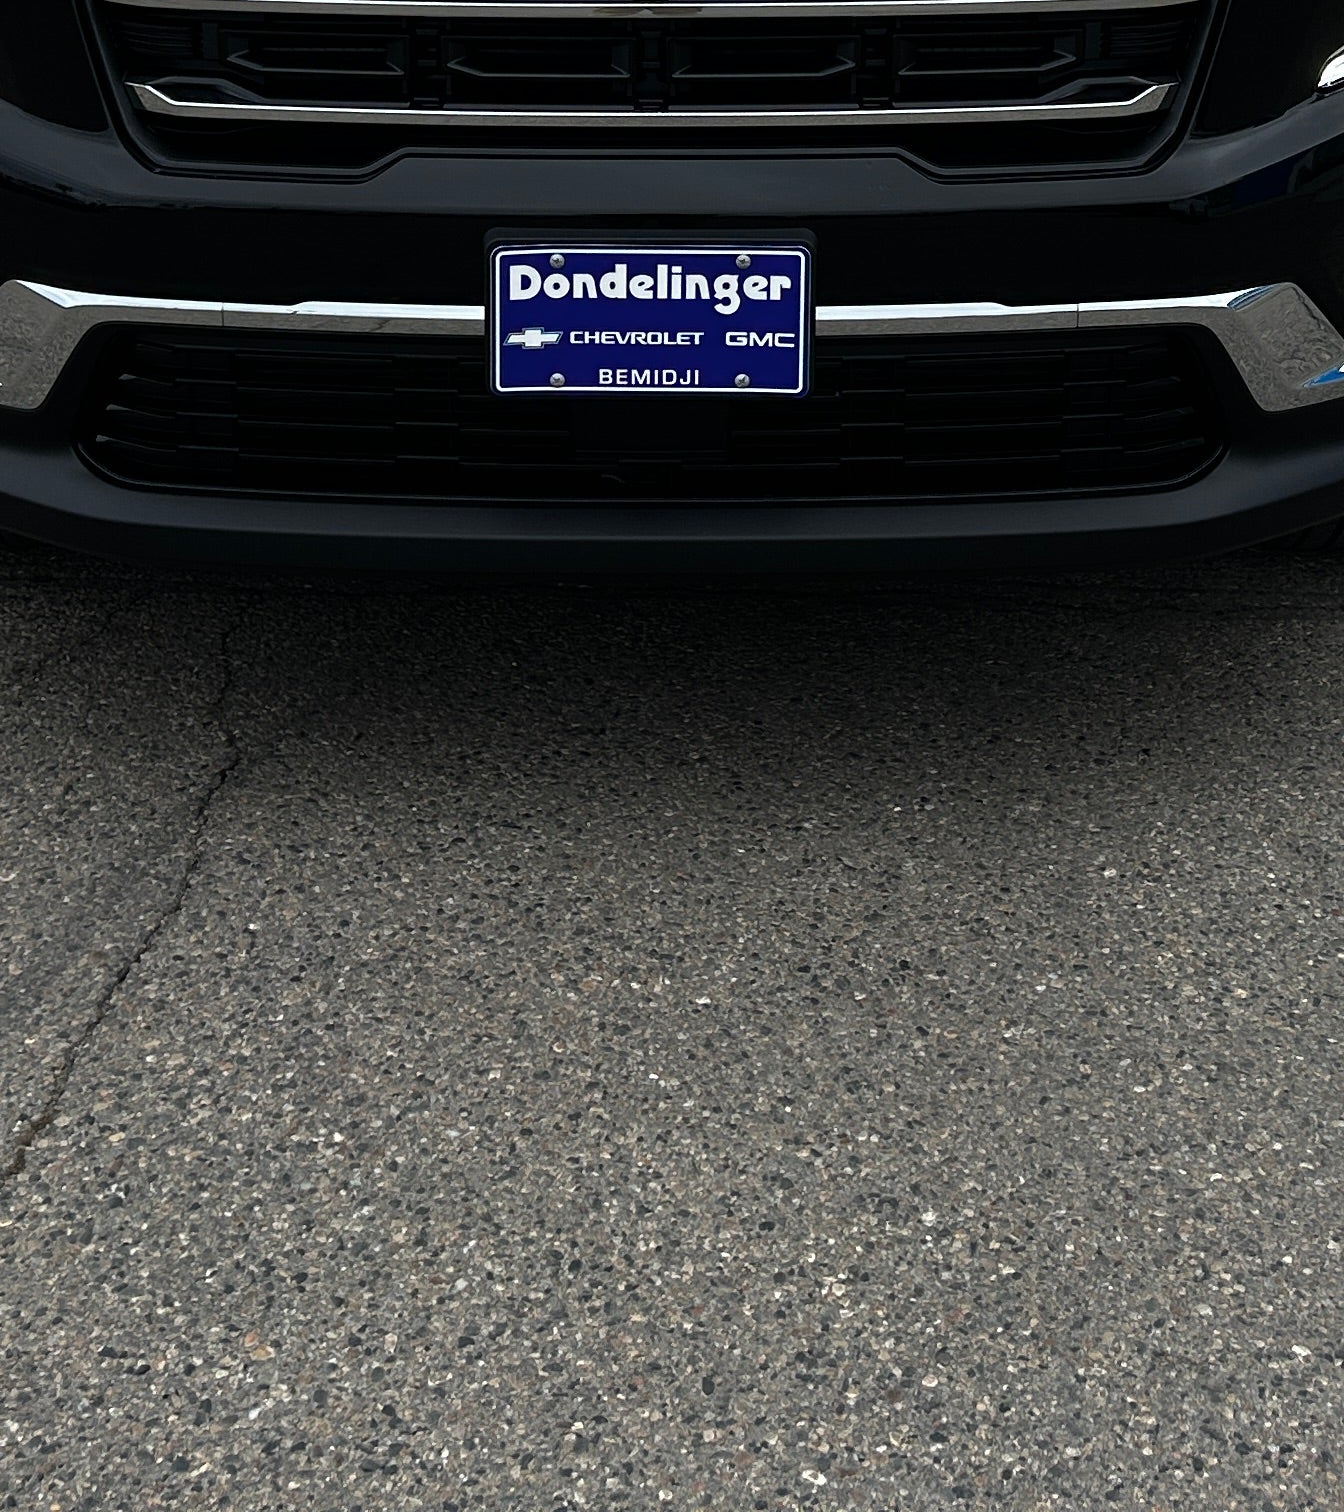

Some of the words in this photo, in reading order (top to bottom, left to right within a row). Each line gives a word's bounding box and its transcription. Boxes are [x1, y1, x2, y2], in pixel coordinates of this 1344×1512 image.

[509, 264, 792, 315] Dondelinger
[569, 331, 704, 345] CHEVROLET
[725, 331, 795, 348] GMC
[598, 368, 699, 385] BEMIDJI
